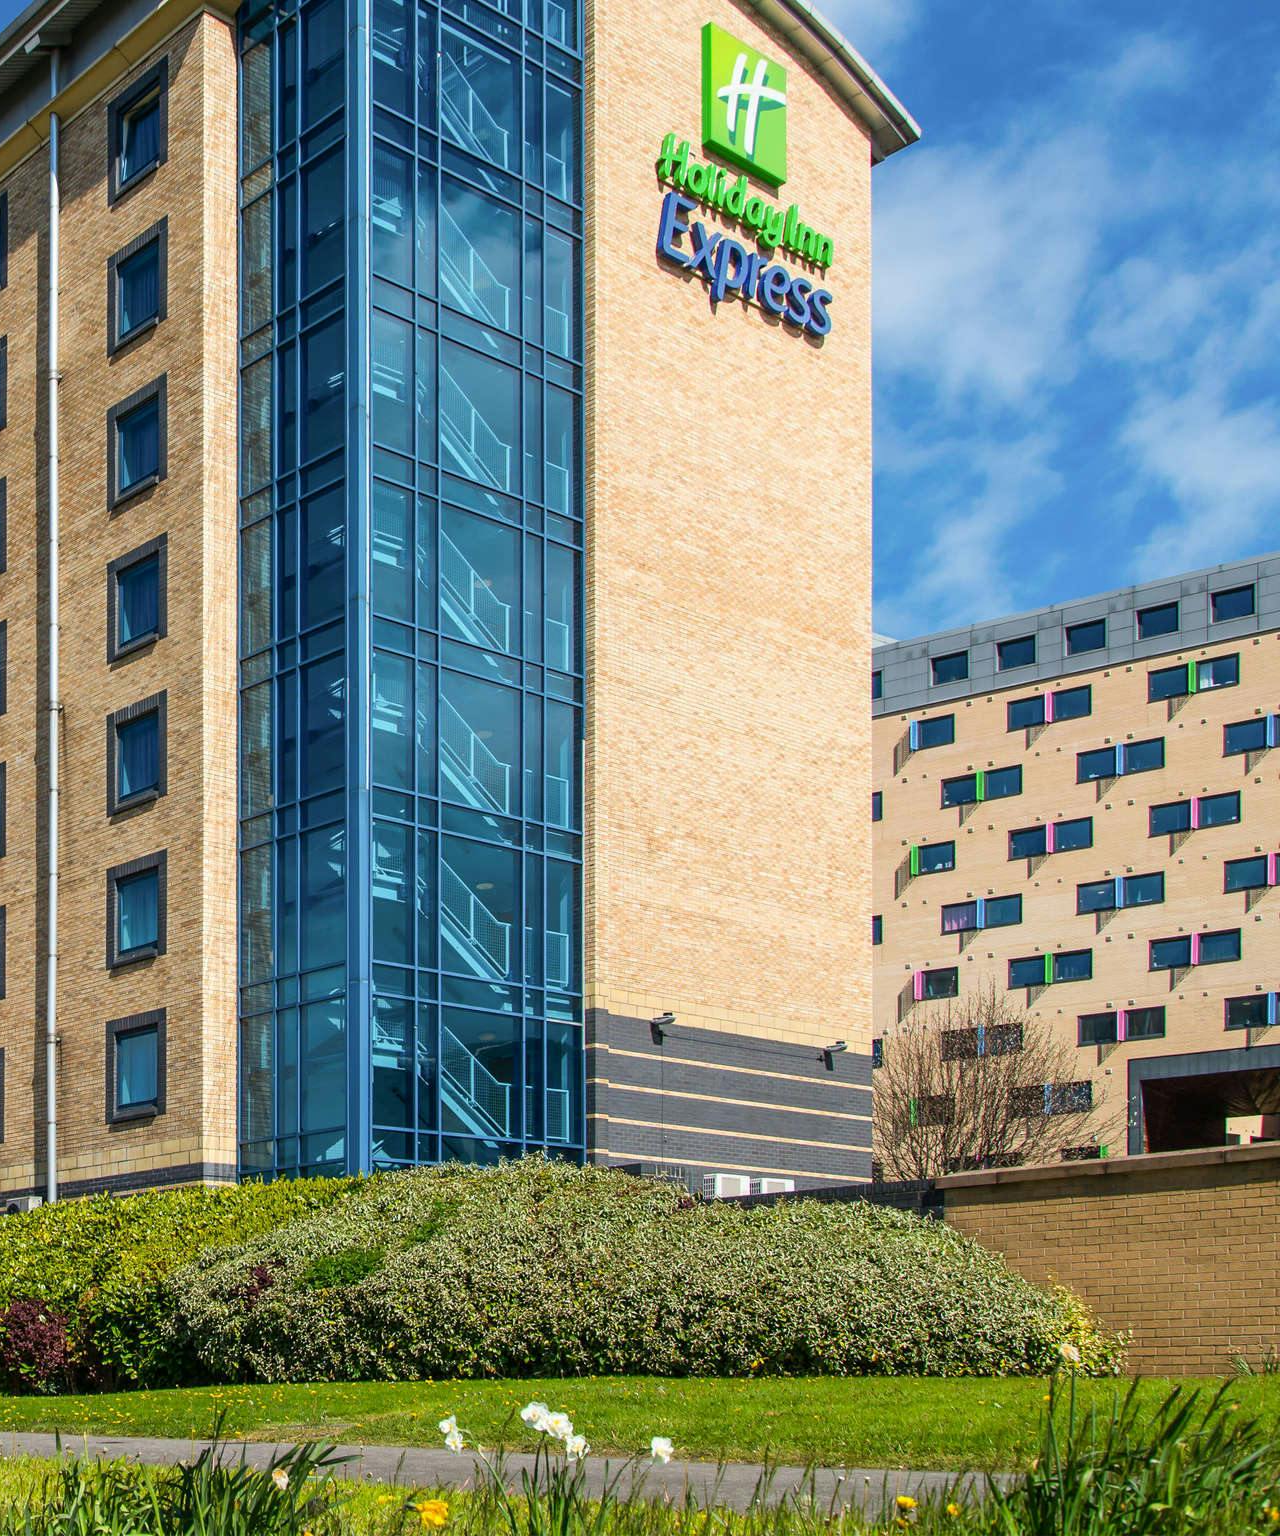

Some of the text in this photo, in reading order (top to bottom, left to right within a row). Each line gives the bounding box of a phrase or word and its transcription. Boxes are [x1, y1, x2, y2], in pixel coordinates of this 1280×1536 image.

[656, 132, 834, 268] Holiday Inn
[656, 191, 832, 336] Express
